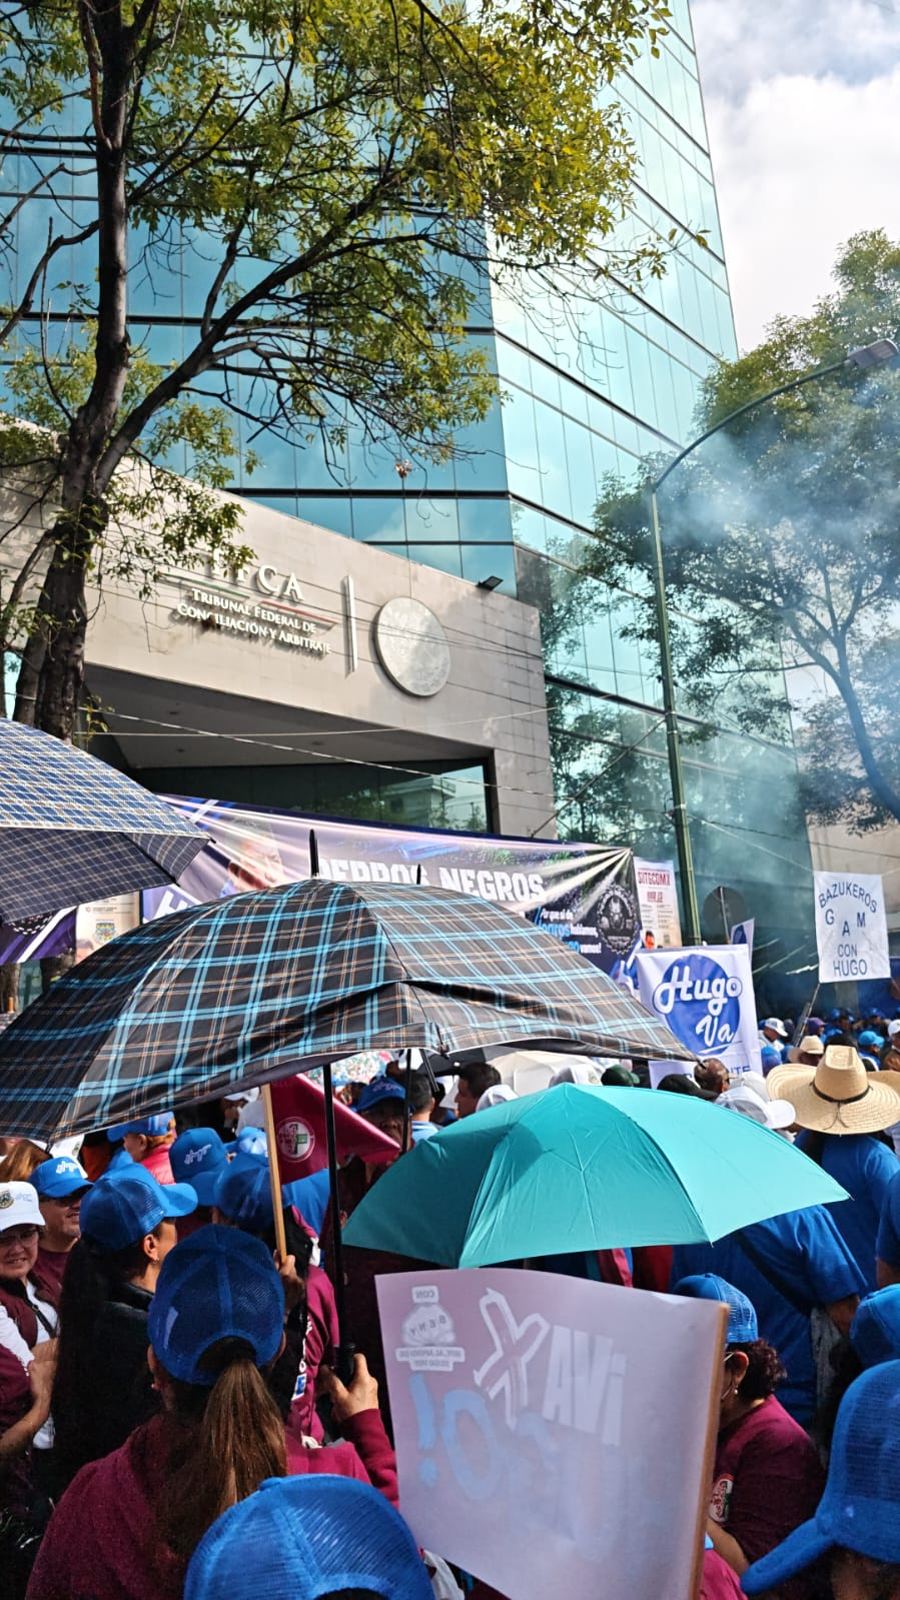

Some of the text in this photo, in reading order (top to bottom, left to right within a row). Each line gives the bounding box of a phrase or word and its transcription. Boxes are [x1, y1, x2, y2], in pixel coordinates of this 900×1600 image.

[191, 588, 317, 633] TRIBUNAL FEDERAL DE
[268, 628, 277, 640] Y
[439, 866, 546, 902] NEGROS
[818, 881, 877, 914] BAZUKEROS
[837, 944, 858, 958] CON
[833, 959, 868, 977] HUGO
[655, 965, 743, 1016] Hugo
[696, 1017, 736, 1047] Va
